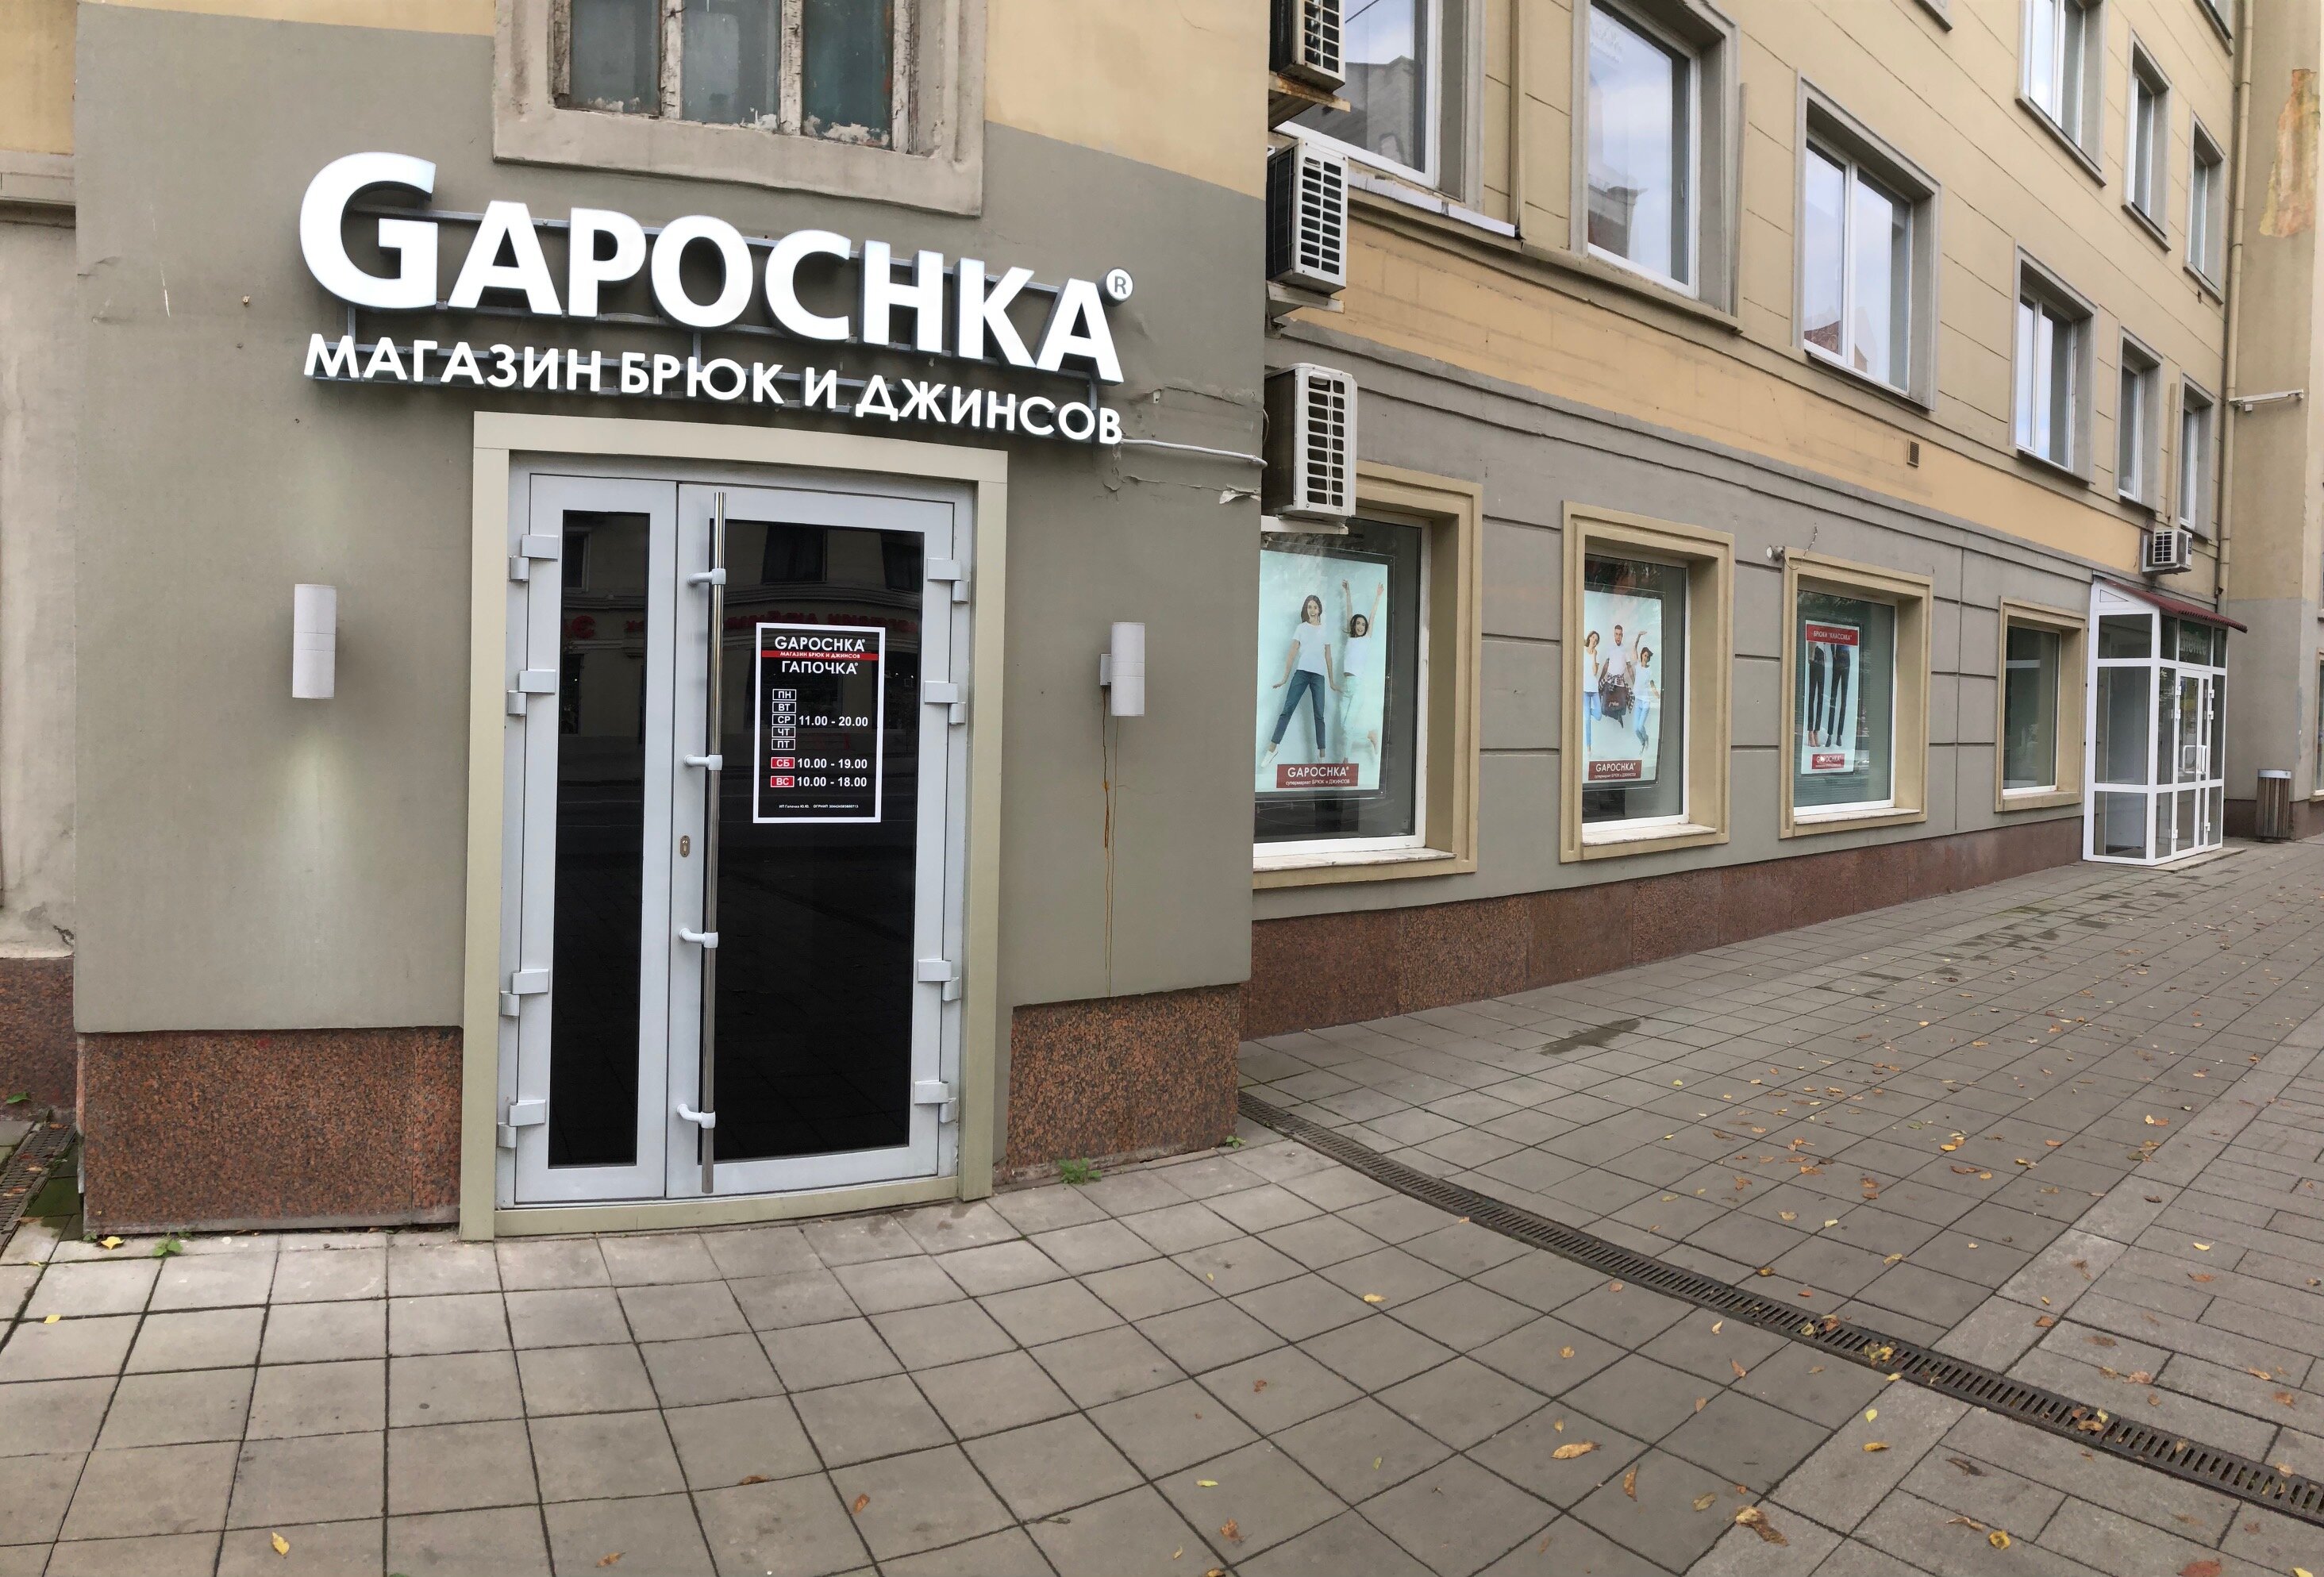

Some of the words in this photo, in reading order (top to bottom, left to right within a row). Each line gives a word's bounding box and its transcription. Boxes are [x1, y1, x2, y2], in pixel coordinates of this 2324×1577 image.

[299, 151, 1124, 386] GAPOCHKA
[303, 333, 602, 393] МАГАЗИН
[621, 351, 784, 405] БРЮК
[804, 366, 838, 410] И
[854, 374, 1123, 445] ДЖИНСОВ
[775, 636, 865, 652] GAPOCHKA
[781, 660, 857, 675] ГАПОЧКА
[778, 690, 792, 699] ПН
[778, 703, 791, 712] ВТ
[777, 715, 791, 725] СР
[798, 715, 828, 726] 11.00
[838, 716, 869, 727] 20.00
[777, 728, 791, 737] ЧТ
[777, 740, 791, 749] ПТ
[776, 759, 791, 767] СБ
[797, 758, 827, 769] 10.00
[838, 759, 868, 770] 19.00
[1595, 762, 1635, 772] GAPOCHKA
[1287, 766, 1348, 778] GAPOCHKA
[776, 777, 790, 786] ВС
[797, 776, 827, 787] 10.00
[837, 777, 868, 788] 18.00
